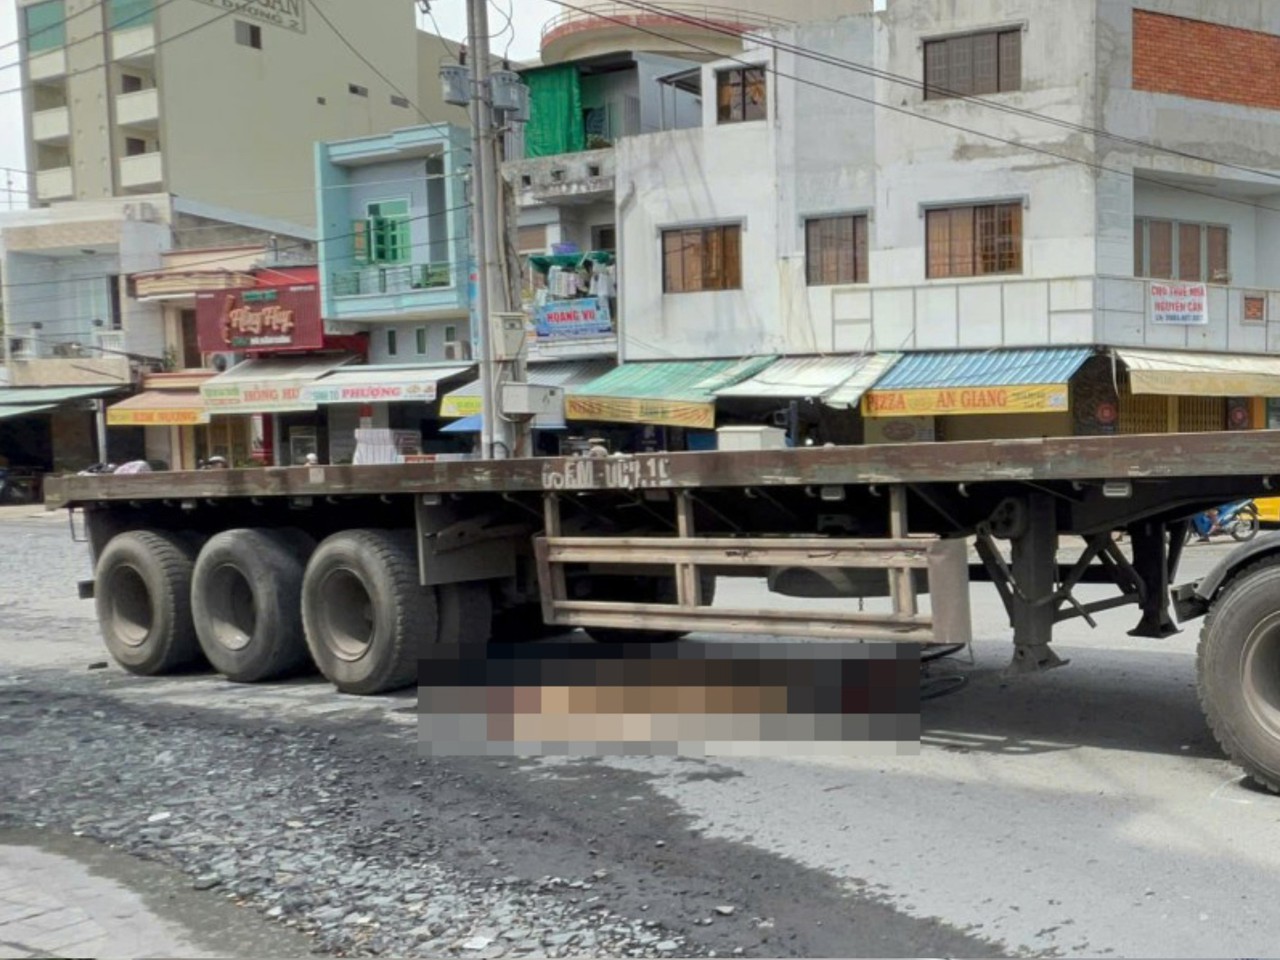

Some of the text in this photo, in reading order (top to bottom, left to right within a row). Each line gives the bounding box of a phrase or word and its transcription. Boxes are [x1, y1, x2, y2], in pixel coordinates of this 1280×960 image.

[866, 393, 906, 412] PIZZA
[936, 391, 957, 408] AN
[960, 389, 1008, 408] GIANG
